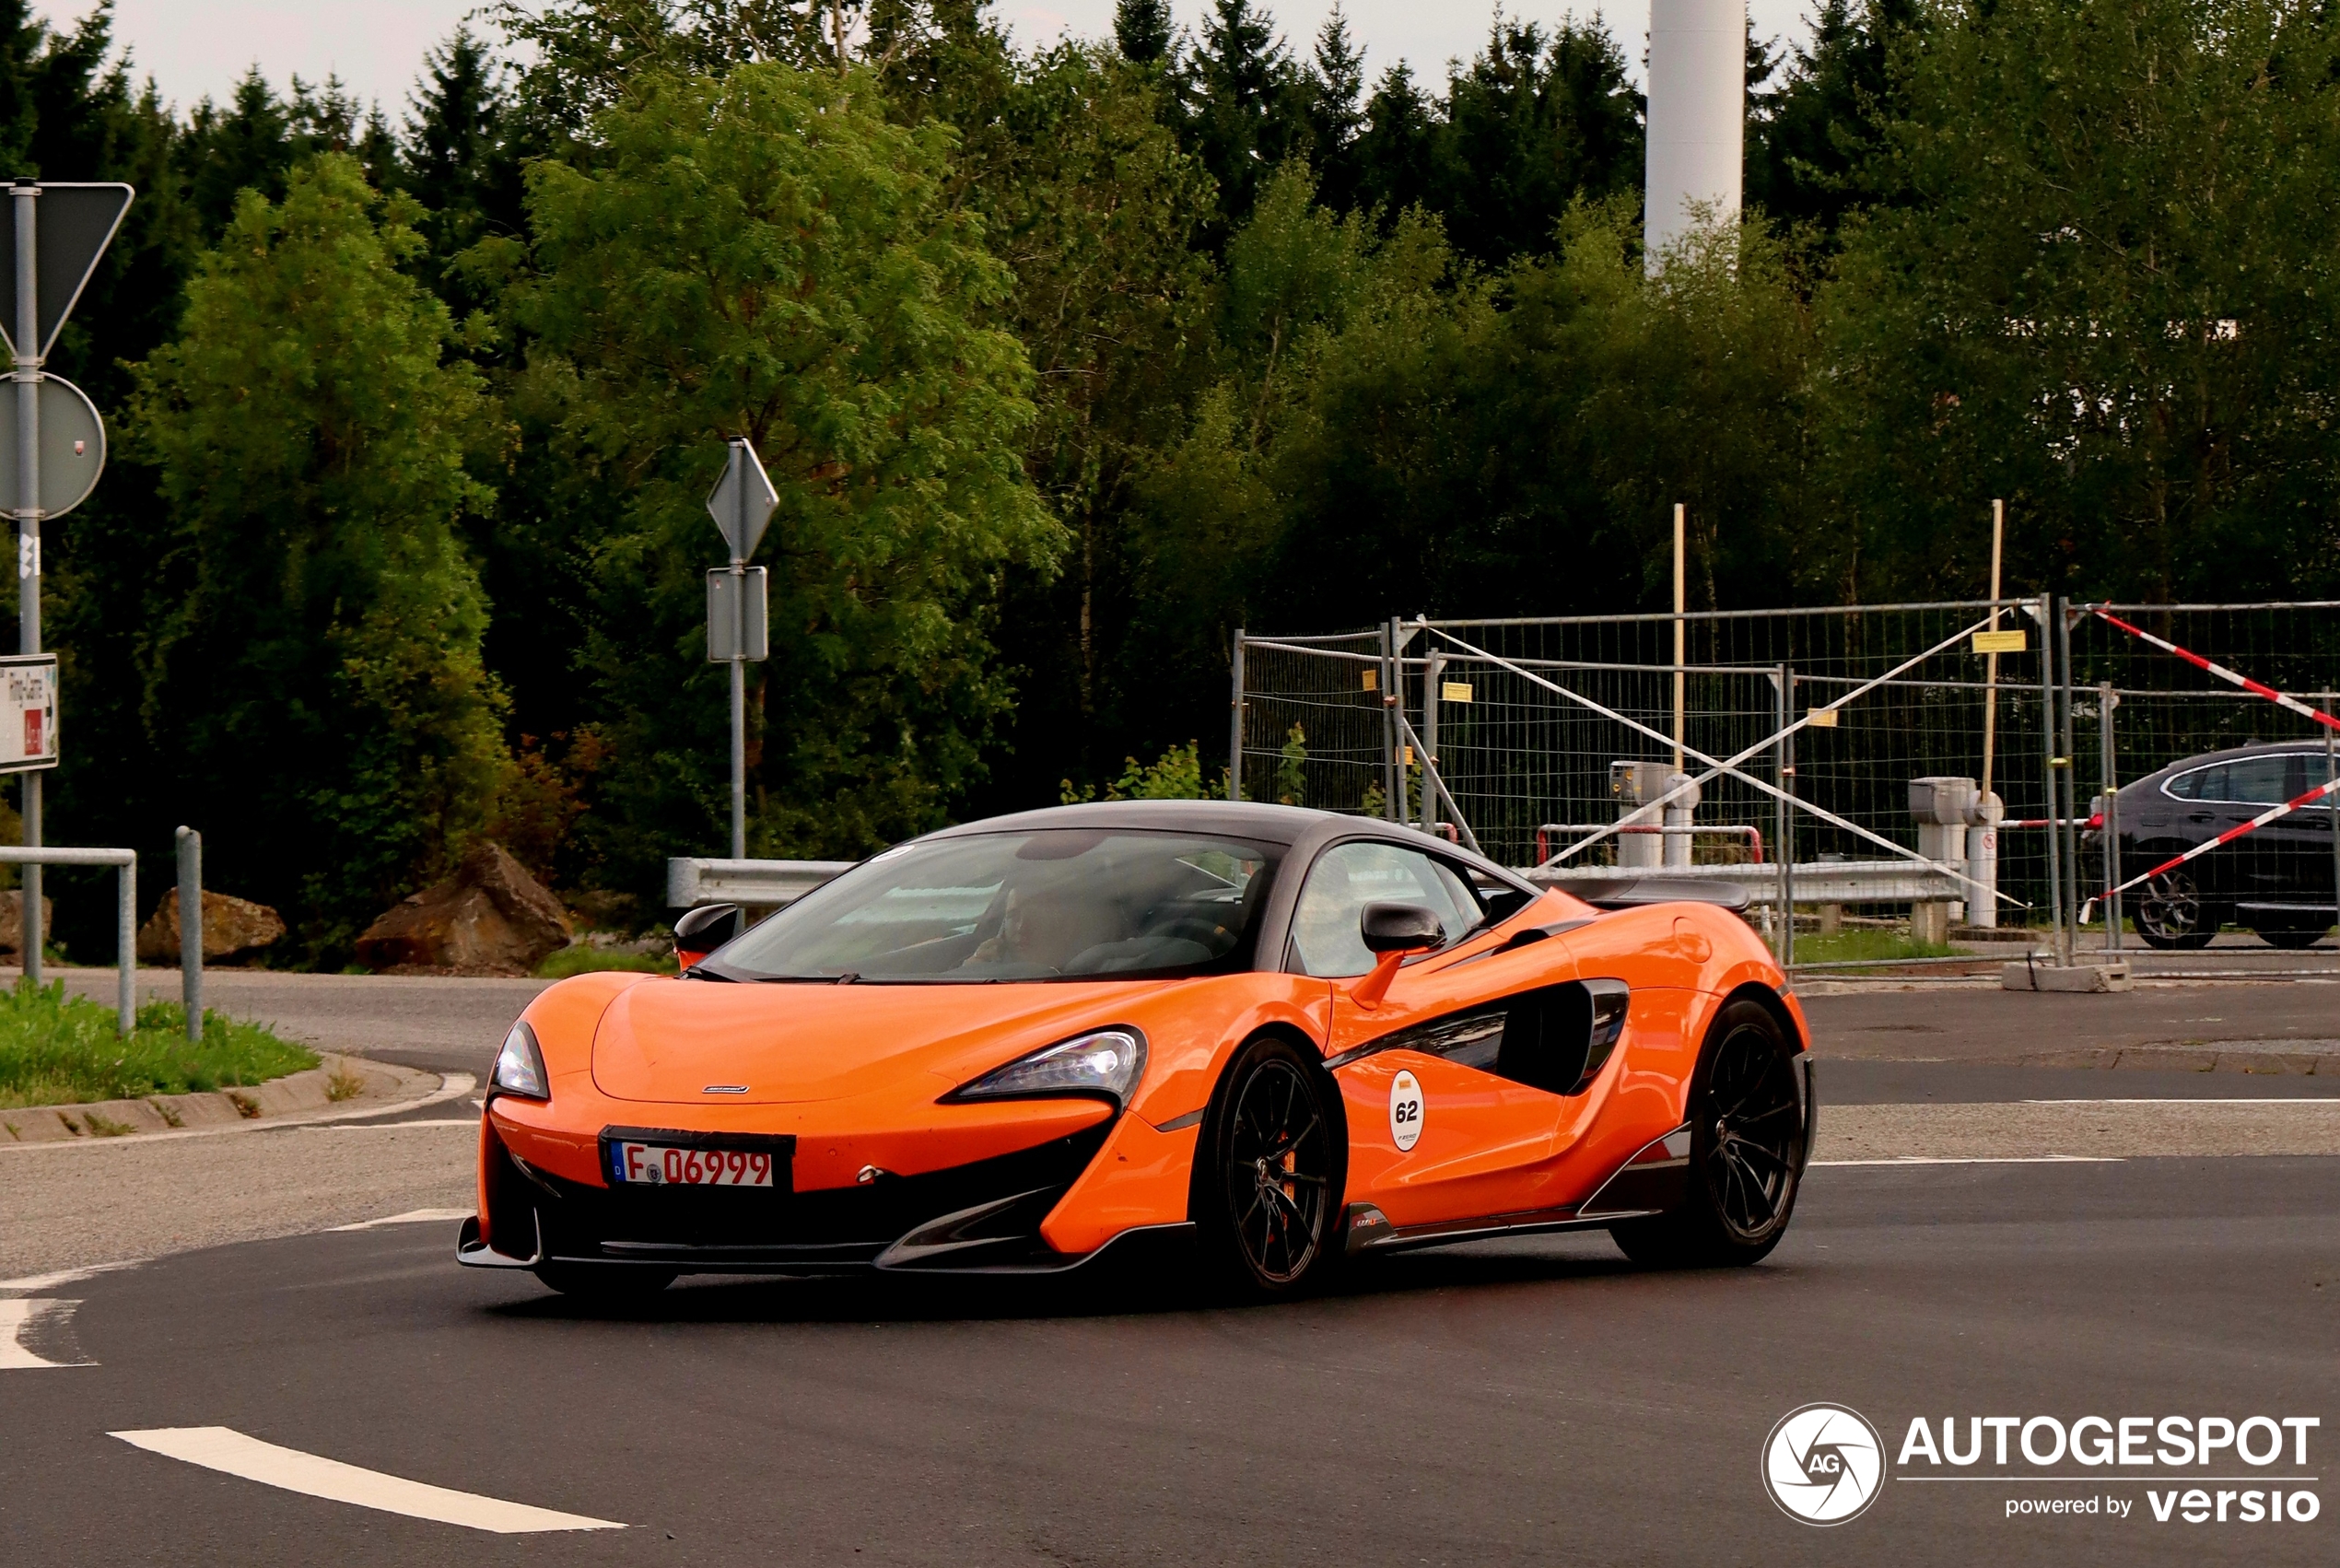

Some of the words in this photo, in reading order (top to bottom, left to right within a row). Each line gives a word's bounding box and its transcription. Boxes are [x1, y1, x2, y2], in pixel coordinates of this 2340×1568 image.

[1395, 1100, 1419, 1124] 62
[614, 1165, 621, 1176] D
[626, 1146, 645, 1179] F
[664, 1149, 770, 1185] 06999
